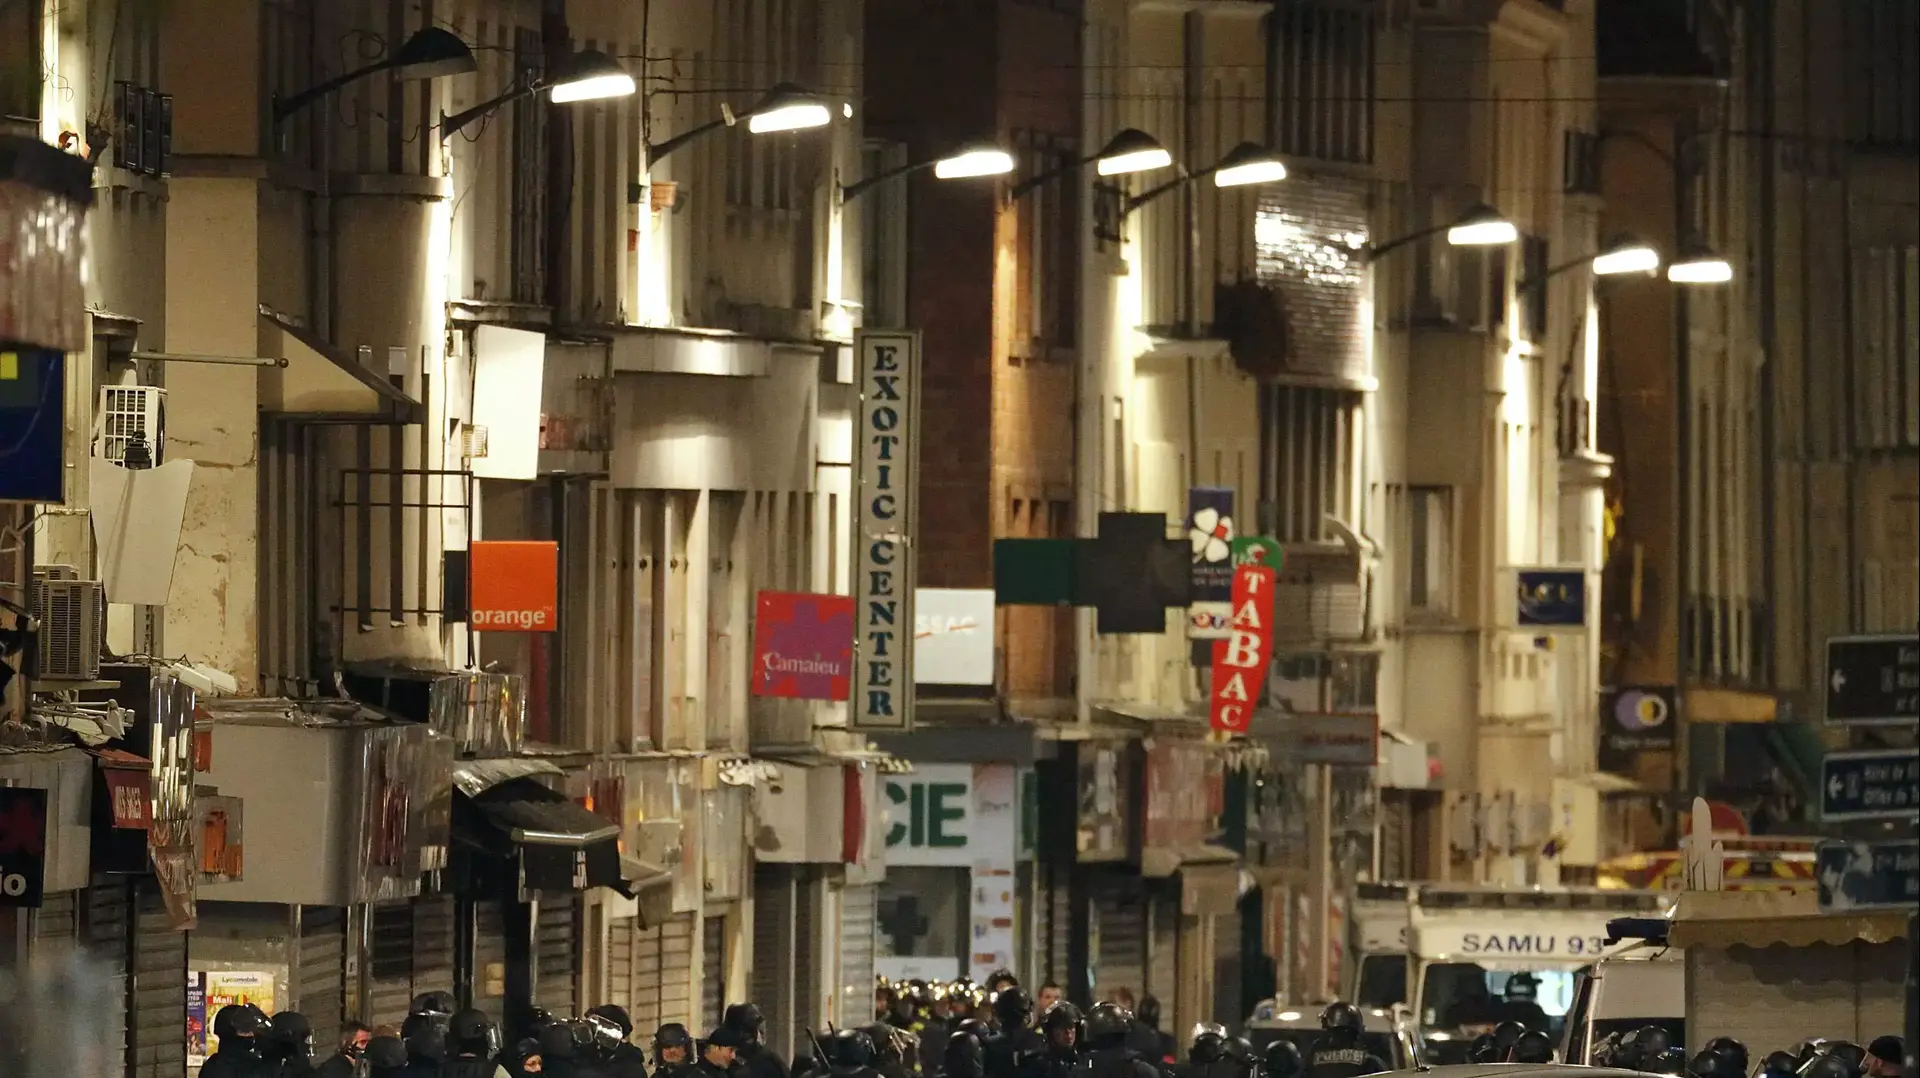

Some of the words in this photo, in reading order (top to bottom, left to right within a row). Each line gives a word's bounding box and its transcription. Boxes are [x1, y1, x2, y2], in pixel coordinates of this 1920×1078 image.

[871, 345, 900, 520] EXOTIC
[472, 610, 546, 629] orange
[867, 541, 897, 716] CENTER
[1218, 571, 1262, 728] TABAC
[1462, 933, 1555, 954] SAMU
[1567, 936, 1603, 954] 93
[213, 996, 233, 1004] Mali
